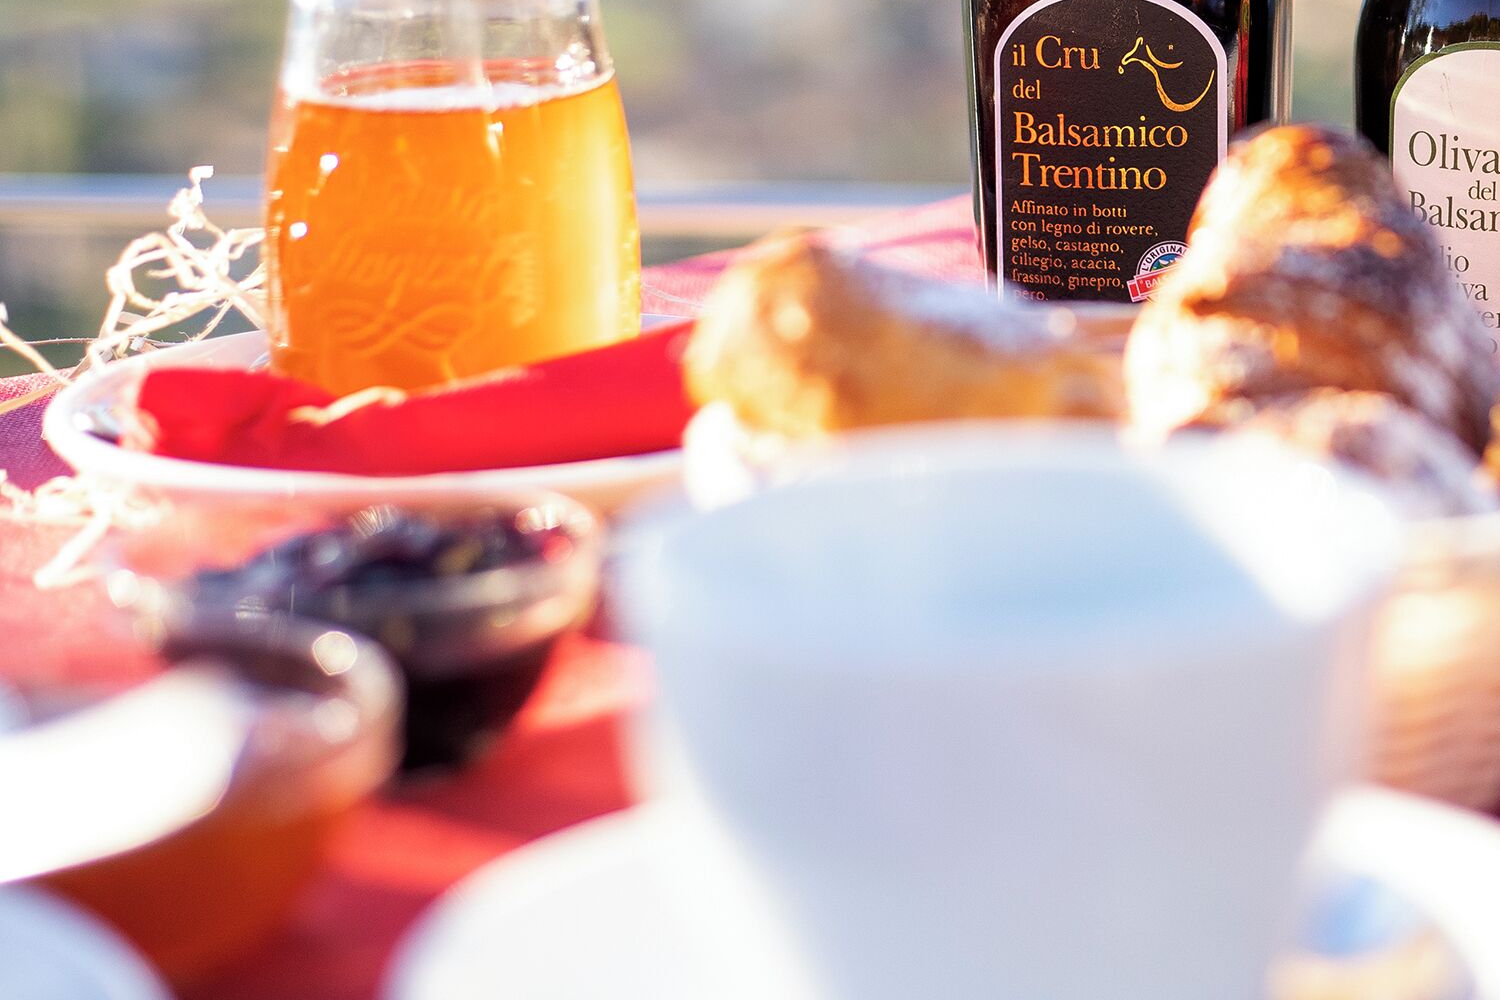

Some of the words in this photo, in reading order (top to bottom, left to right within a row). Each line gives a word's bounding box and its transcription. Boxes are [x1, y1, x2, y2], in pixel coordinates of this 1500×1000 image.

[1012, 44, 1026, 67] il
[1035, 35, 1100, 70] Cru
[1012, 79, 1041, 100] del
[1013, 111, 1188, 148] Balsamico
[1012, 152, 1167, 190] Trentino
[1468, 180, 1497, 201] del
[1011, 200, 1069, 217] Affinato
[1073, 203, 1087, 217] in
[1093, 204, 1127, 218] botti
[1011, 219, 1037, 231] con
[1042, 219, 1082, 237] legno
[1087, 222, 1100, 235] di
[1106, 225, 1159, 237] rovere,
[1011, 236, 1052, 252] gelso,
[1055, 241, 1124, 257] castagno,
[1011, 252, 1067, 271] ciliegio,
[1071, 257, 1121, 271] acacia,
[1011, 269, 1065, 287] frassino,
[1068, 273, 1125, 291] ginepro,
